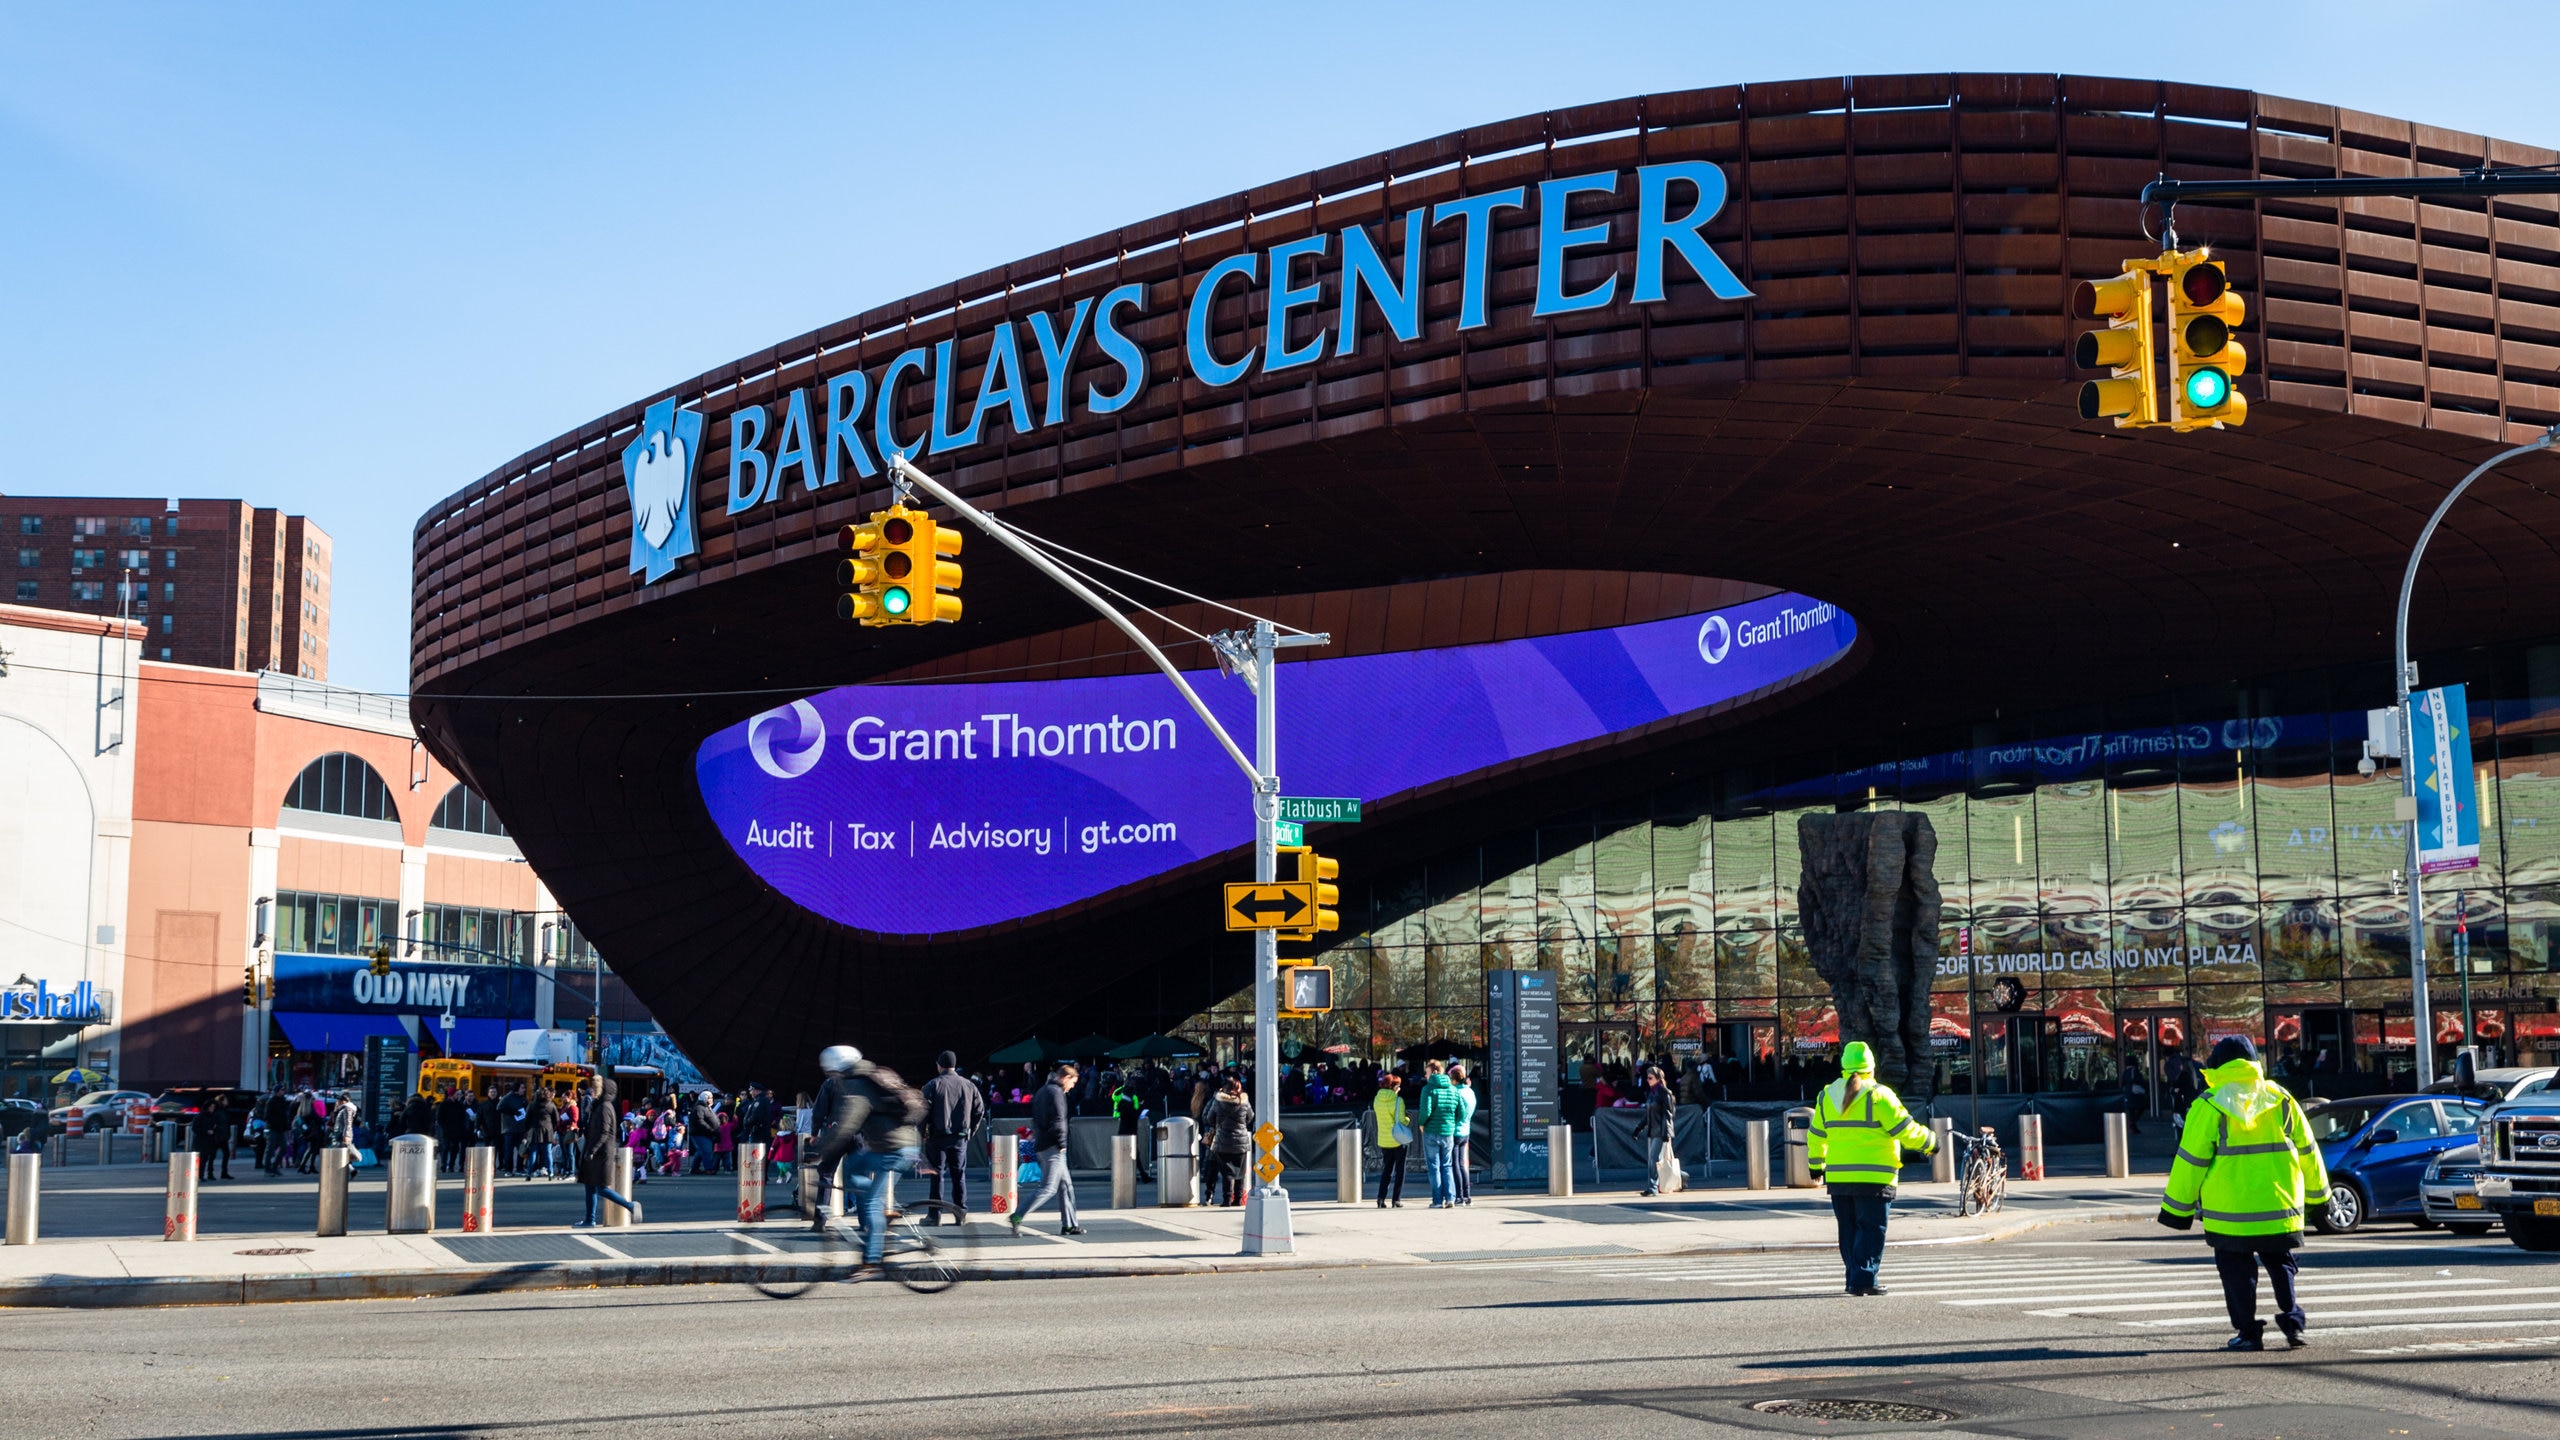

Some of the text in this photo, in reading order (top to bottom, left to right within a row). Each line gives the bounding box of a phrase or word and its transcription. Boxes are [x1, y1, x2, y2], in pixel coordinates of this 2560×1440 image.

[726, 160, 1757, 517] BARCLAYS CENTER
[2432, 691, 2446, 743] NORTH
[2441, 751, 2454, 834] FLATBUSH
[1279, 800, 1358, 818] Flatbush Av
[745, 819, 1177, 856] Audit Tax Advisory gt.com
[1276, 823, 1294, 843] acific
[1935, 944, 2257, 975] SORTS WORLD CASINO NYC PLAZA
[1, 979, 102, 1018] rshalls
[353, 969, 470, 1007] OLD NAVY
[1192, 1022, 1242, 1031] STARBUCKS
[1492, 1008, 1502, 1039] PLAY
[2063, 1036, 2098, 1045] PRIORITY
[2536, 1041, 2560, 1050] GEI
[1493, 1051, 1502, 1082] DINE
[1493, 1094, 1502, 1151] UNWIND
[400, 1146, 425, 1154] PLAZA
